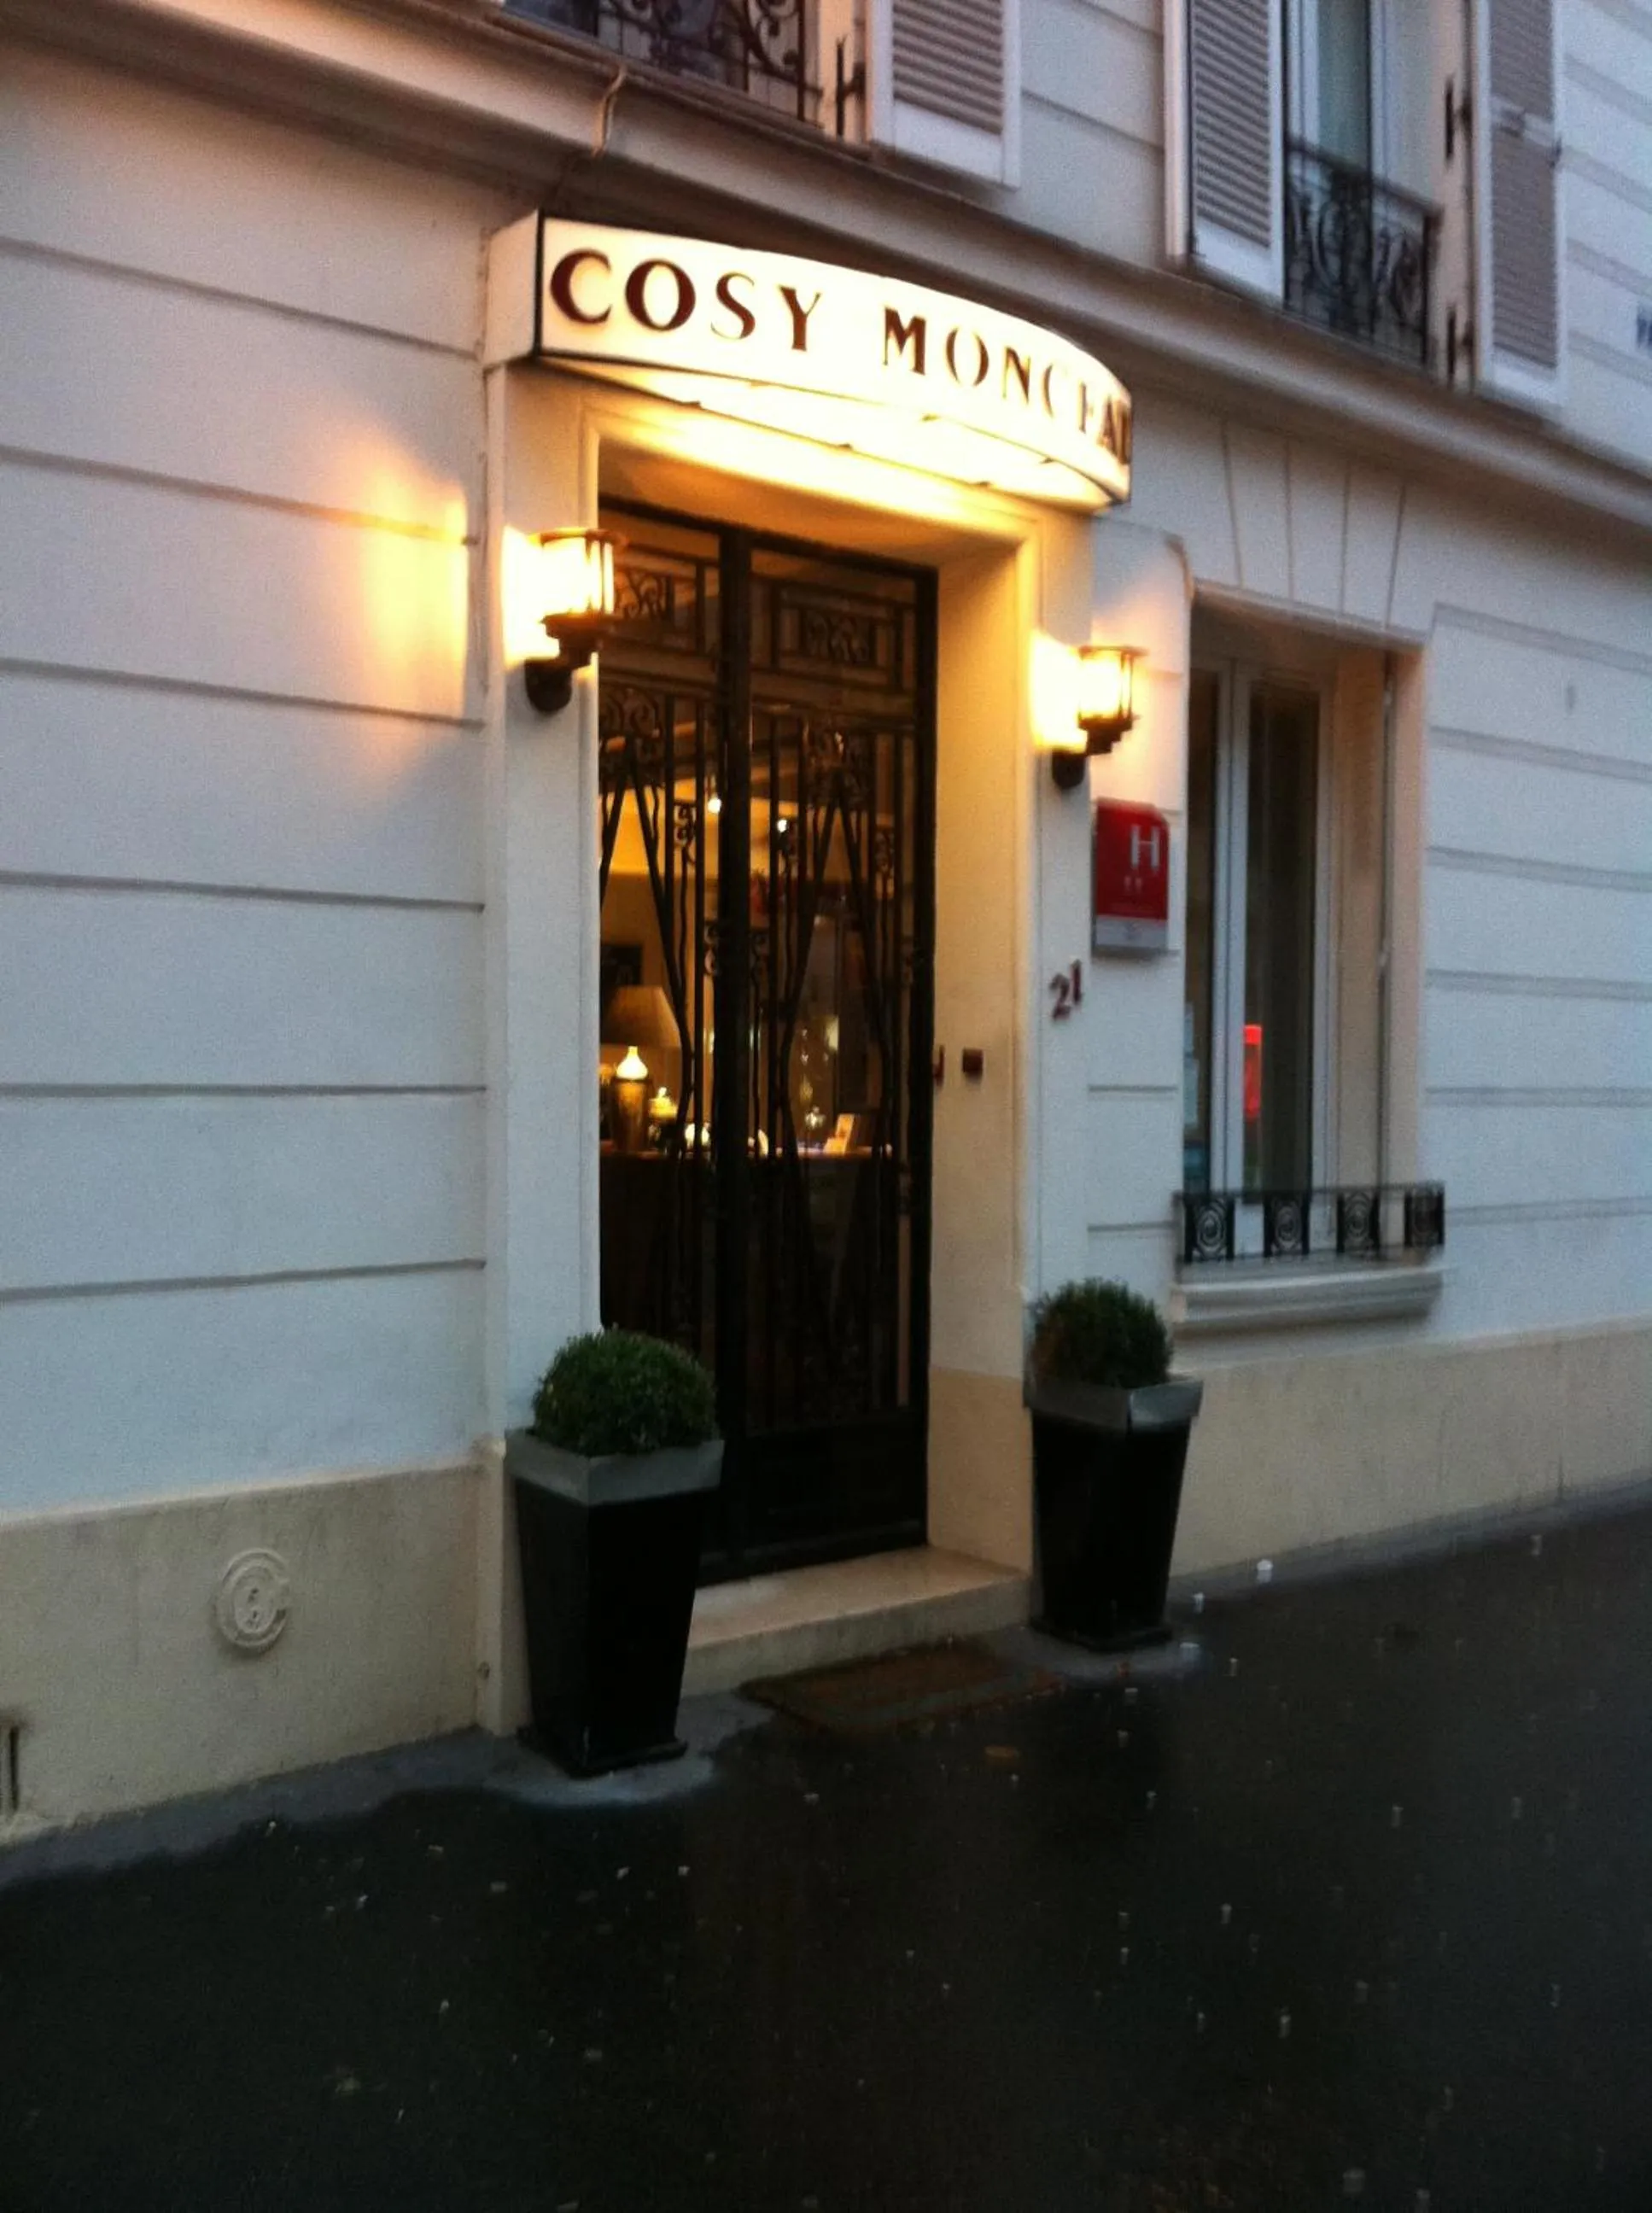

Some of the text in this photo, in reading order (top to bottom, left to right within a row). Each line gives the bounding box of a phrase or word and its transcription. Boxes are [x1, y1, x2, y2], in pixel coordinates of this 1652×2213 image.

[549, 248, 821, 353] COSY
[1130, 824, 1159, 869] H
[1049, 959, 1082, 1020] 21
